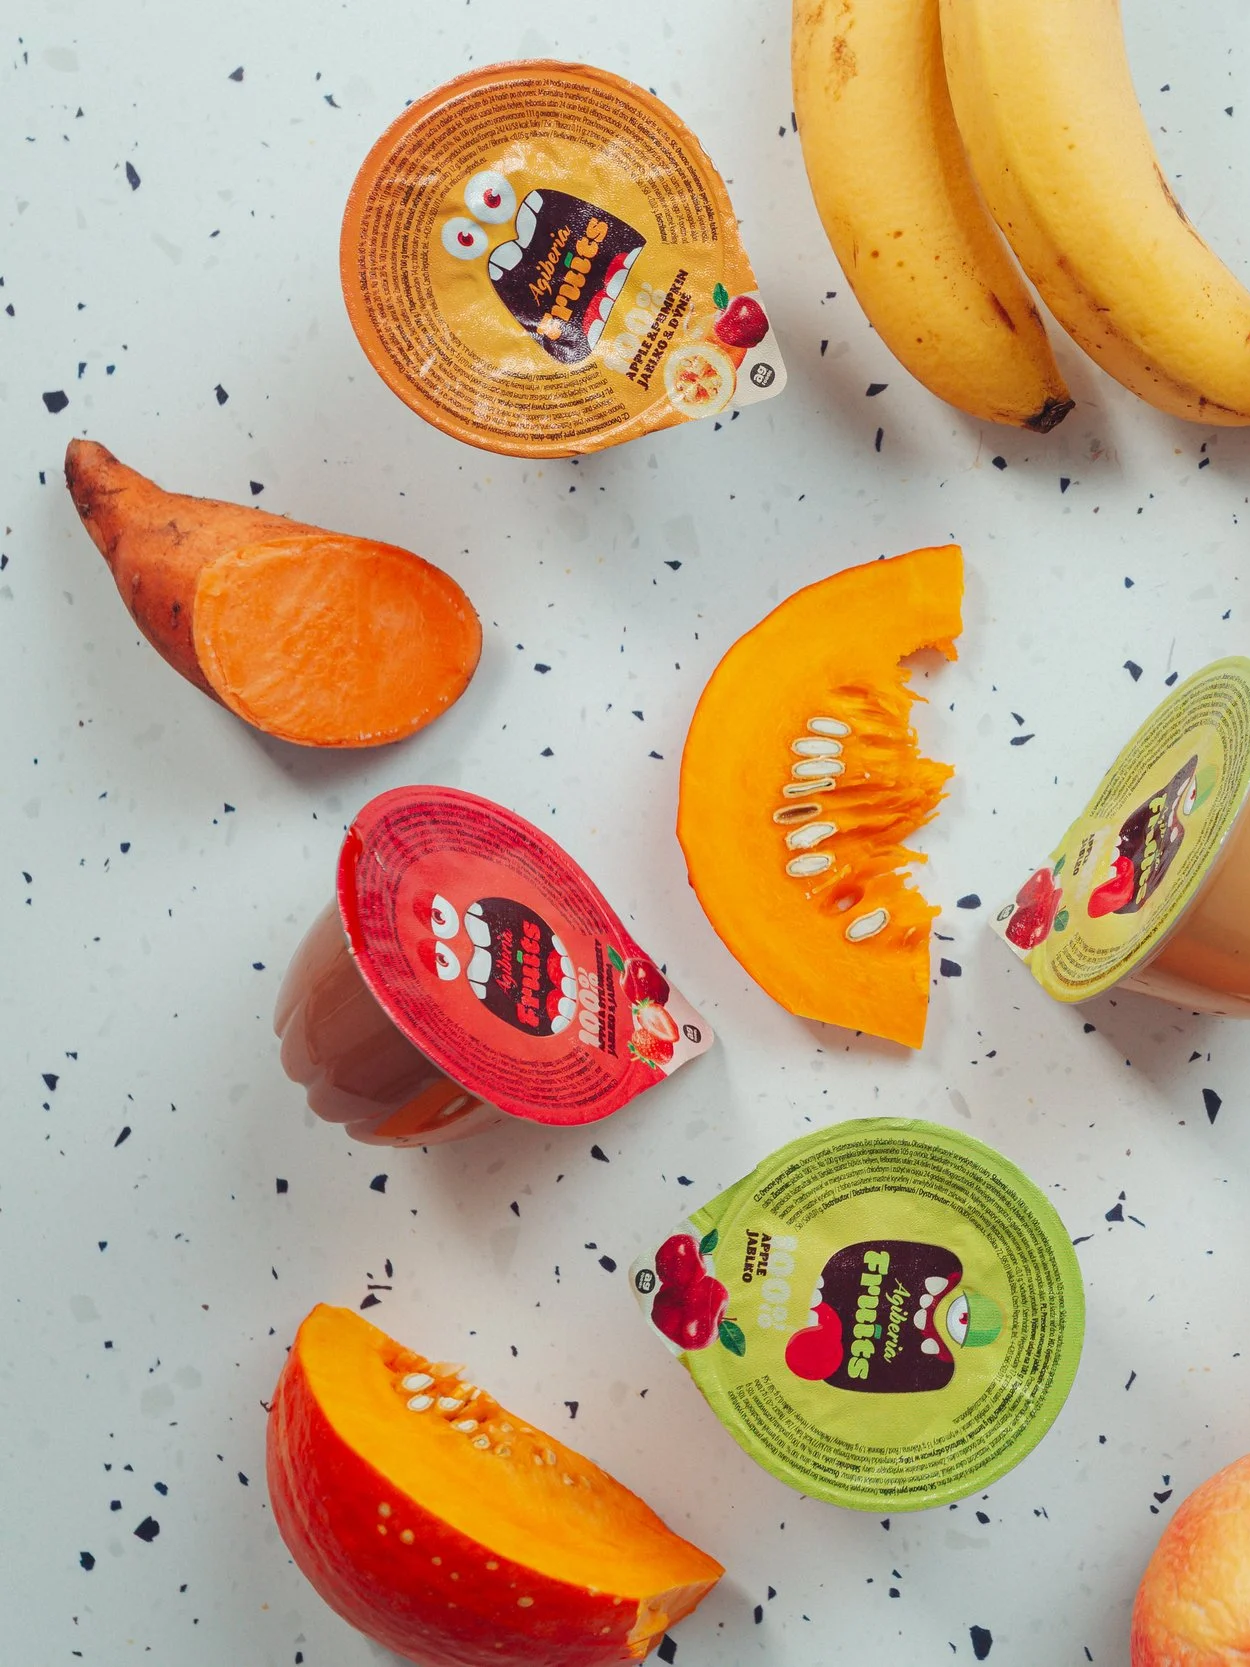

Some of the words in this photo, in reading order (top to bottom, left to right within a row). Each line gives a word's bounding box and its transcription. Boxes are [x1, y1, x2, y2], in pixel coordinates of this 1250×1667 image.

[531, 226, 571, 305] Agiberia
[536, 219, 609, 341] Fruits
[662, 330, 675, 341] &
[668, 292, 692, 329] DÝNĚ
[625, 340, 652, 381] APPLE
[637, 340, 668, 391] JABLKO
[516, 921, 542, 1027] Fruits
[577, 968, 600, 1048] 100%
[743, 1229, 758, 1284] JABLKO
[758, 1233, 772, 1277] APPLE
[848, 1251, 890, 1378] Fruits
[884, 1278, 912, 1365] Agiberia
